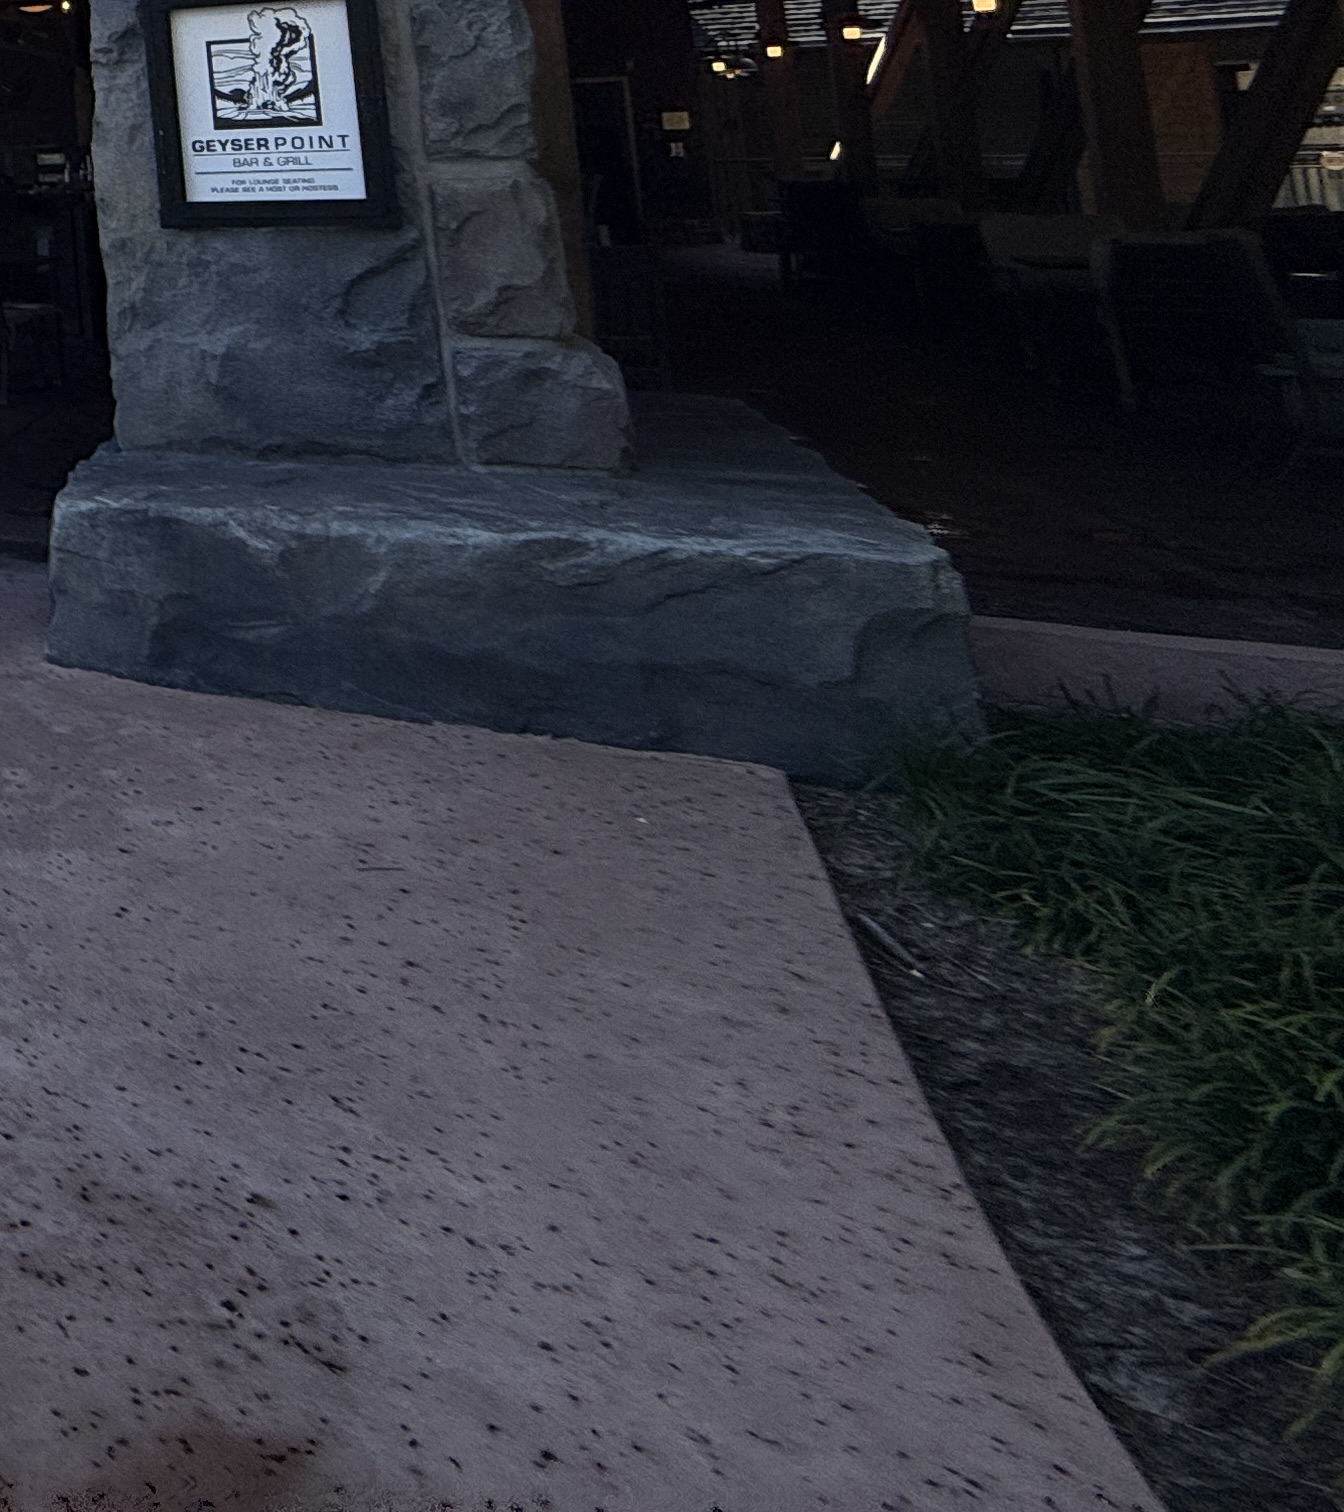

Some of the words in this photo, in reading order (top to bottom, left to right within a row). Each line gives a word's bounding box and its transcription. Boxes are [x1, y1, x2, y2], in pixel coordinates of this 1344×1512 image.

[191, 137, 270, 153] GEYSER
[274, 134, 350, 150] POINT
[232, 157, 259, 168] BAR
[263, 157, 274, 167] &
[277, 155, 313, 167] GRILL
[211, 186, 240, 194] PLEASE
[266, 185, 287, 193] HOST
[302, 184, 339, 192] HOSTESS
